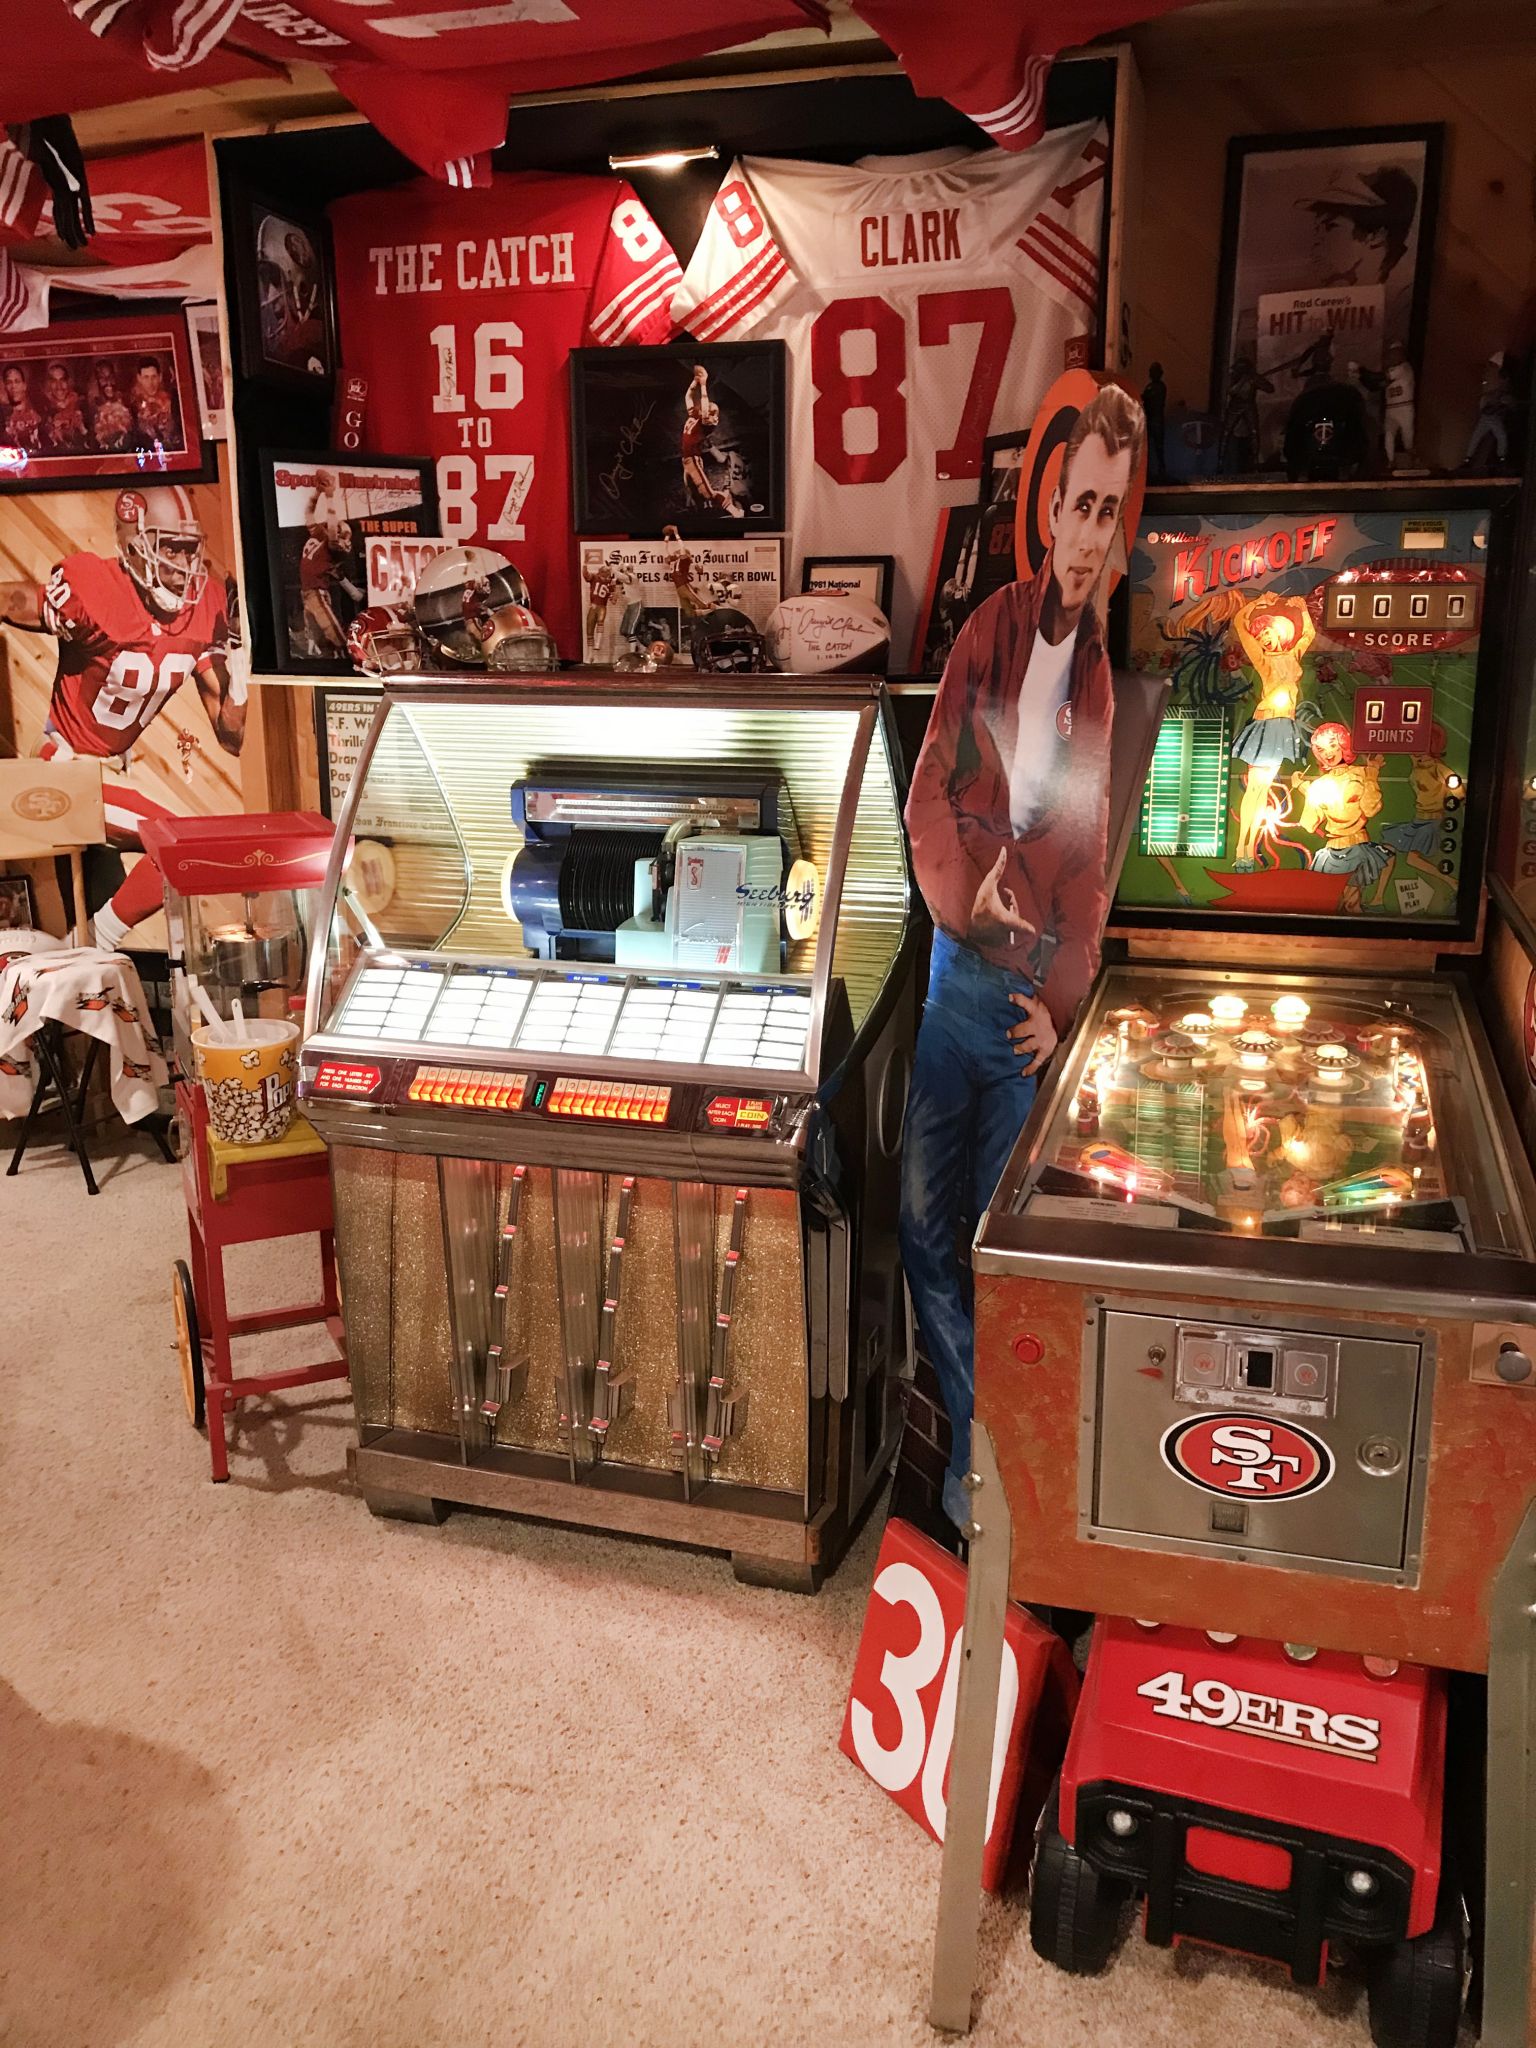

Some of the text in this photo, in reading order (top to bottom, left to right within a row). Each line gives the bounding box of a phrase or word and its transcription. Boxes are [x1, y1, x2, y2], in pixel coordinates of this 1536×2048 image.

[715, 181, 764, 248] 8
[611, 199, 663, 262] 8
[860, 208, 962, 267] CLARK
[369, 232, 575, 295] THE CATCH
[1293, 299, 1312, 309] Rod
[1270, 310, 1307, 336] HIT
[1328, 306, 1376, 331] WIN
[430, 321, 524, 413] 16
[810, 287, 1017, 485] 87
[457, 416, 492, 448] TO
[436, 454, 535, 541] 87
[360, 520, 417, 534] THE SUPER
[702, 549, 749, 564] Journal
[1170, 518, 1337, 608] KICKOFF
[747, 571, 776, 582] BOWL
[827, 579, 861, 589] National
[1338, 597, 1464, 617] 0 0 0 0
[1364, 633, 1433, 646] SCORE
[92, 650, 198, 730] 80
[328, 702, 374, 713] 49ERS IN
[1367, 702, 1420, 723] 0 0
[1368, 729, 1414, 743] POINTS
[1446, 799, 1455, 809] 4
[1445, 820, 1453, 830] 3
[1444, 841, 1452, 851] 2
[1442, 863, 1449, 872] 1
[735, 882, 816, 911] Seeburg
[1400, 883, 1419, 893] BALLS
[1406, 891, 1415, 900] TO
[1404, 899, 1420, 909] PLAY
[739, 1111, 764, 1119] COIN
[1210, 1425, 1300, 1491] SF
[1136, 1670, 1381, 1752] 49ERS
